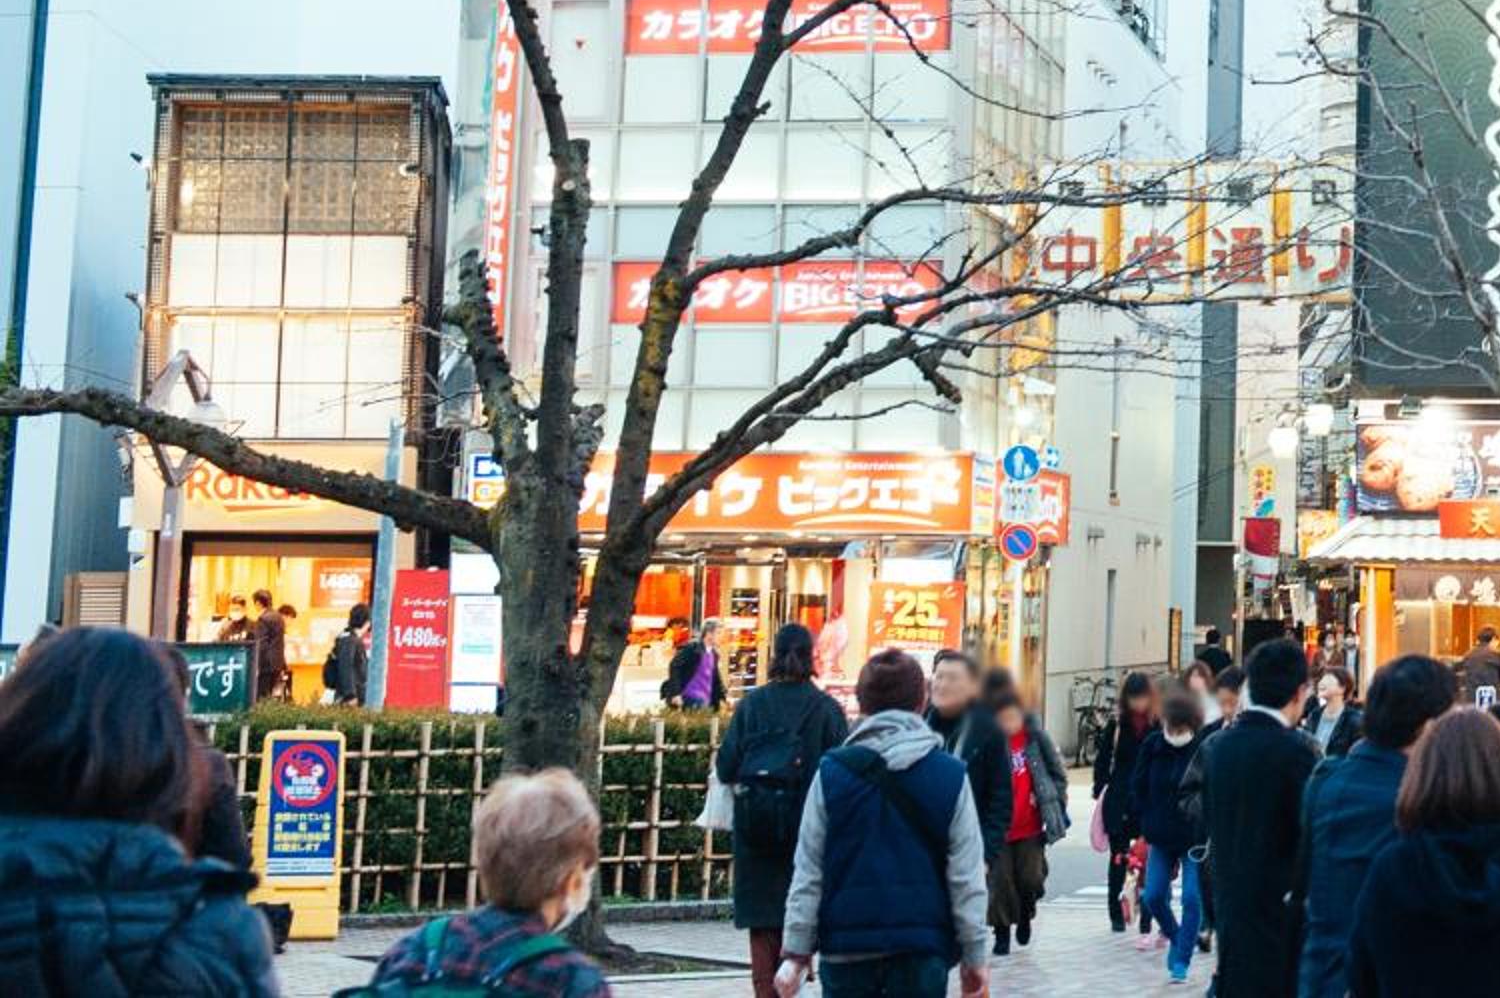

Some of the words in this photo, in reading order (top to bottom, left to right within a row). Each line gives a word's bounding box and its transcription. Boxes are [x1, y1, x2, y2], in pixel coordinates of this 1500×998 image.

[1041, 227, 1350, 283] 中央通り
[627, 278, 770, 310] カオケ
[784, 282, 840, 313] BIG
[578, 472, 763, 518] カケ
[892, 591, 940, 627] 25
